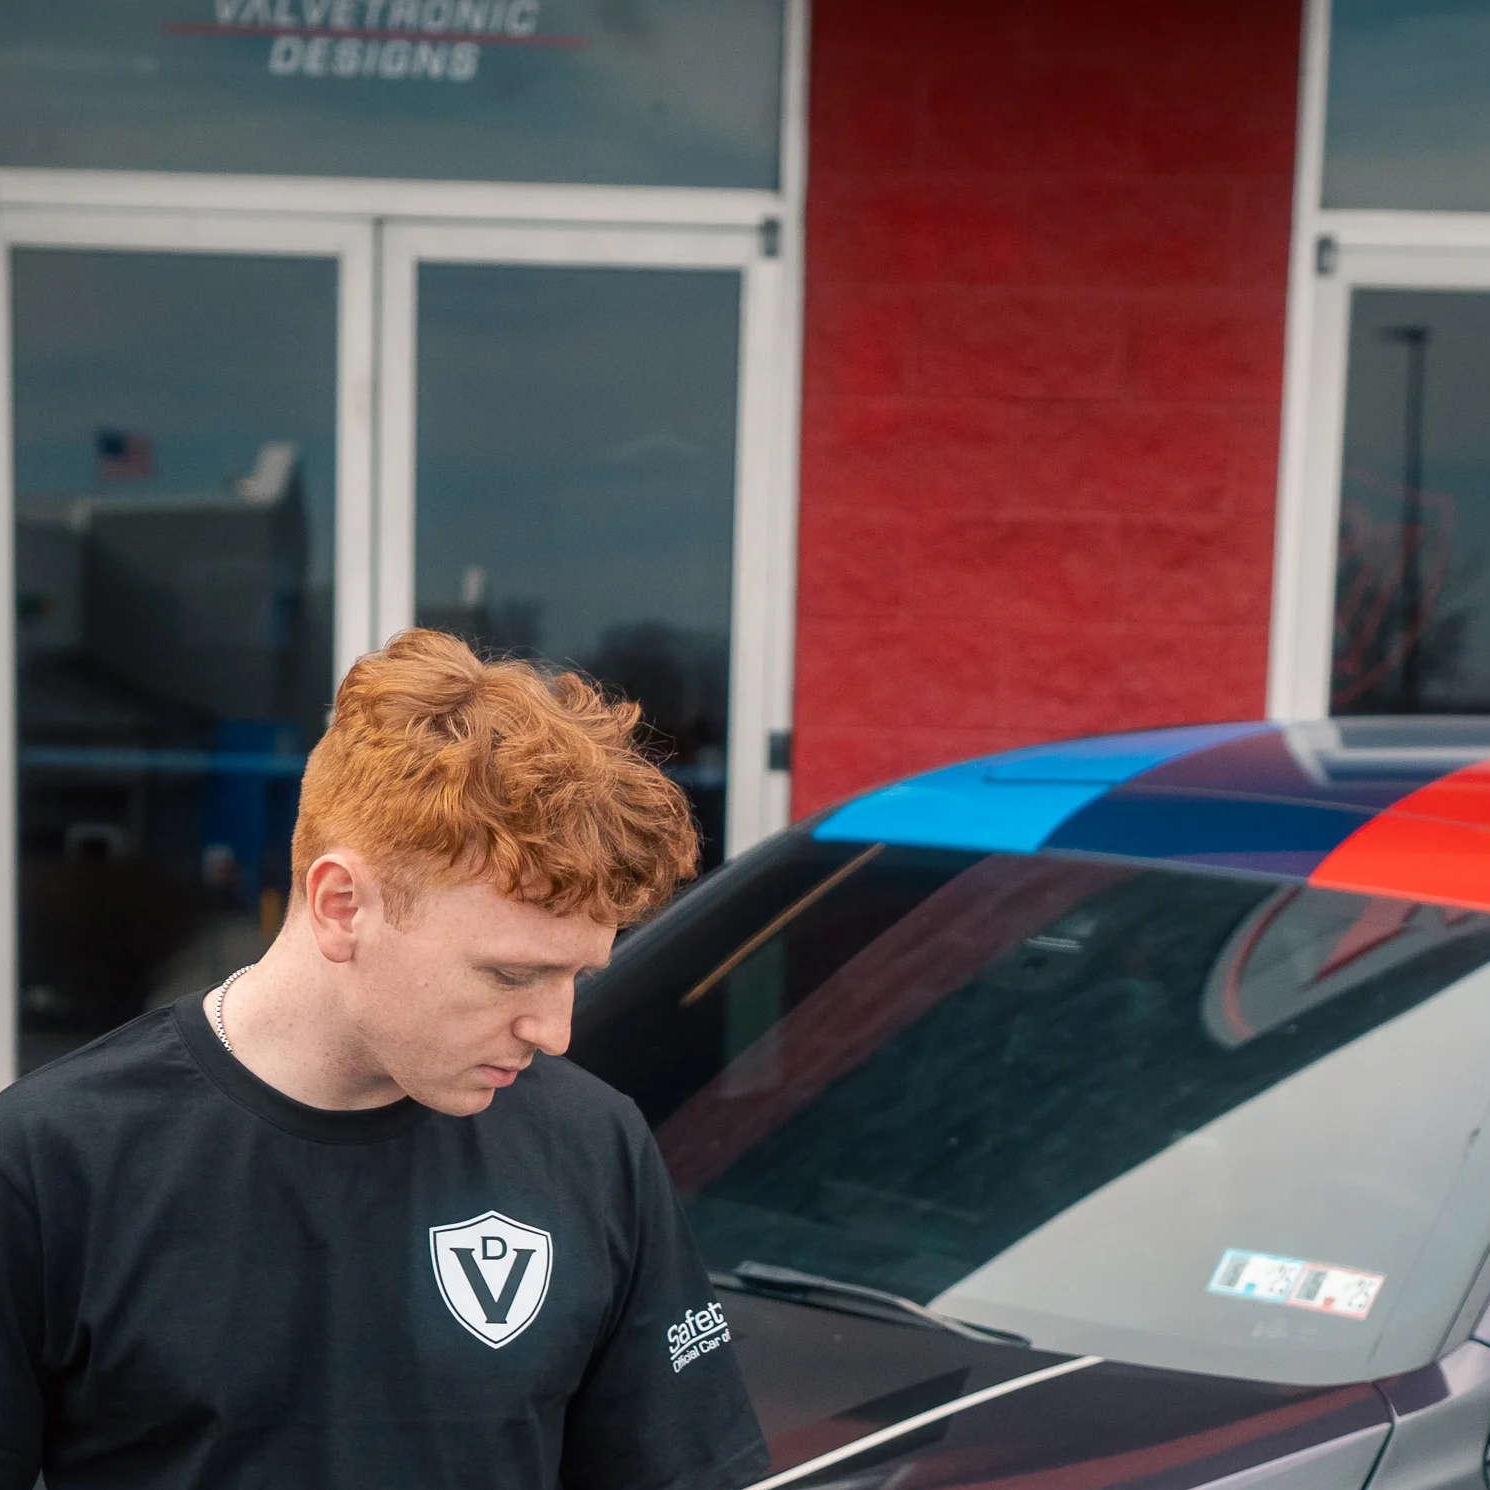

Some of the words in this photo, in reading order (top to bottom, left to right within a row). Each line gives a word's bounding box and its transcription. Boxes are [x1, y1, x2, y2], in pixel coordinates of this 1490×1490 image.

[212, 0, 539, 35] VALVETRONIC
[268, 36, 480, 82] DESIGNS
[480, 1235, 508, 1262] D
[667, 1302, 725, 1354] Safet
[672, 1345, 701, 1373] Official
[698, 1336, 721, 1353] Car
